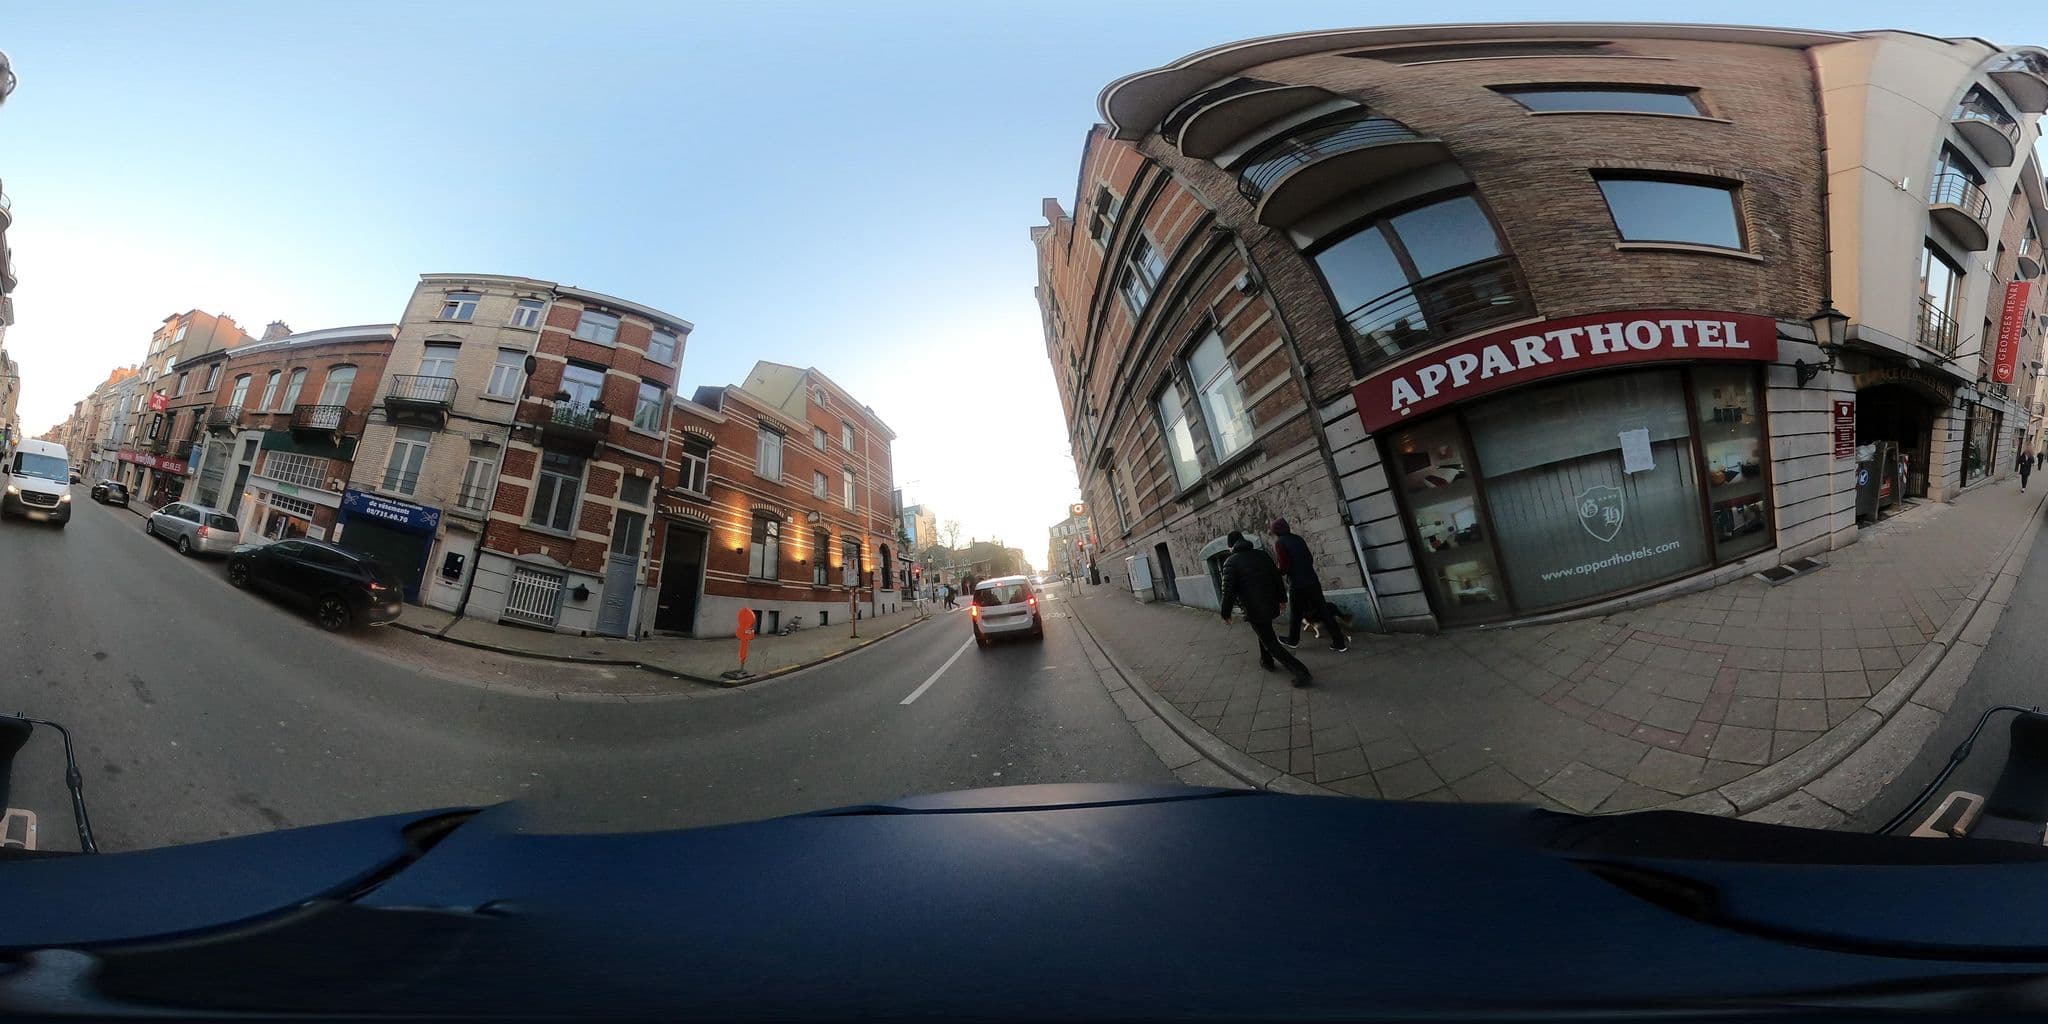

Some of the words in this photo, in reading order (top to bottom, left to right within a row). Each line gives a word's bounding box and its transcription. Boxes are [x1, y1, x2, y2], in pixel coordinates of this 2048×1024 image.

[1998, 315, 2013, 361] GEORGES
[2006, 283, 2019, 312] HENRI
[1391, 319, 1749, 411] APPARTHOTEL
[1541, 540, 1681, 581] www.apparthotels.com
